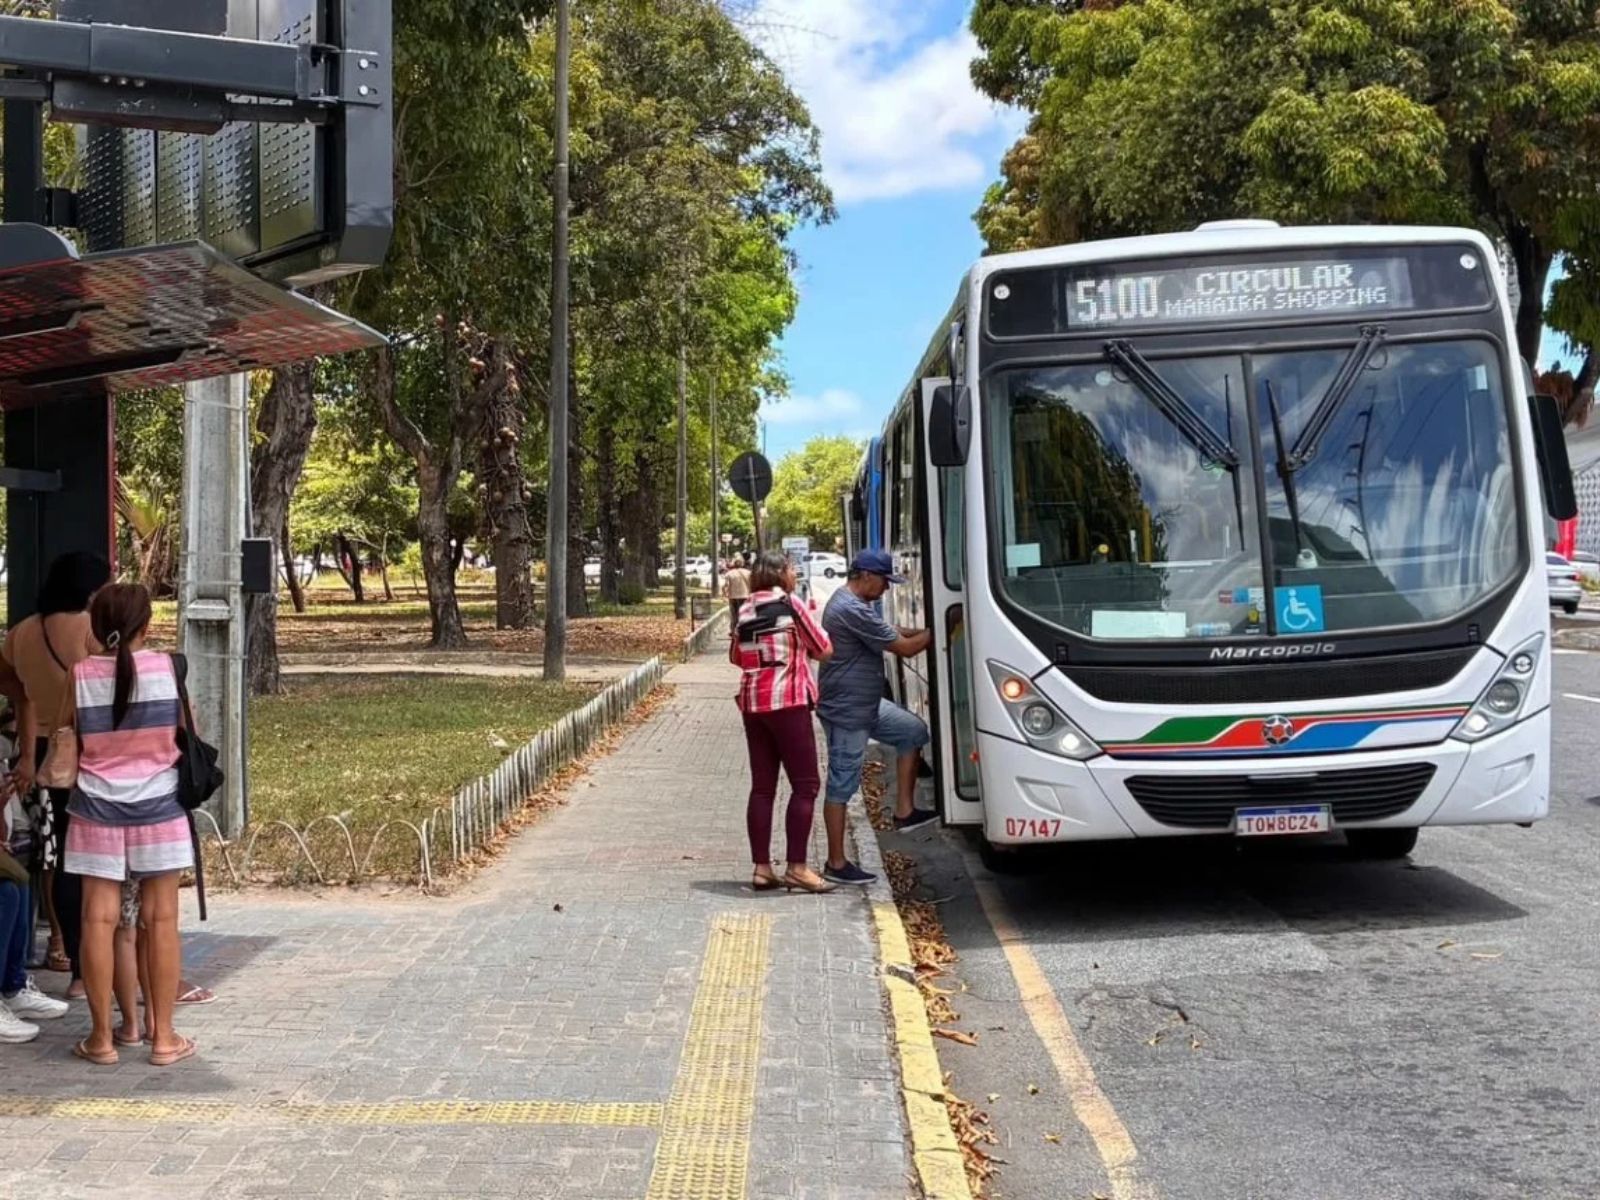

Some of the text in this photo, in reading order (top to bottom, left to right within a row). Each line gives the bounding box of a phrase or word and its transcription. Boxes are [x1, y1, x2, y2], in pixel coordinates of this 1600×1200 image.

[1195, 264, 1354, 296] CIRCULAR
[1076, 276, 1158, 322] 5100
[1272, 286, 1388, 310] SHOPPING
[1209, 642, 1336, 660] Marcopolo
[1005, 818, 1061, 837] 07147
[1246, 814, 1319, 833] TOW8C24
